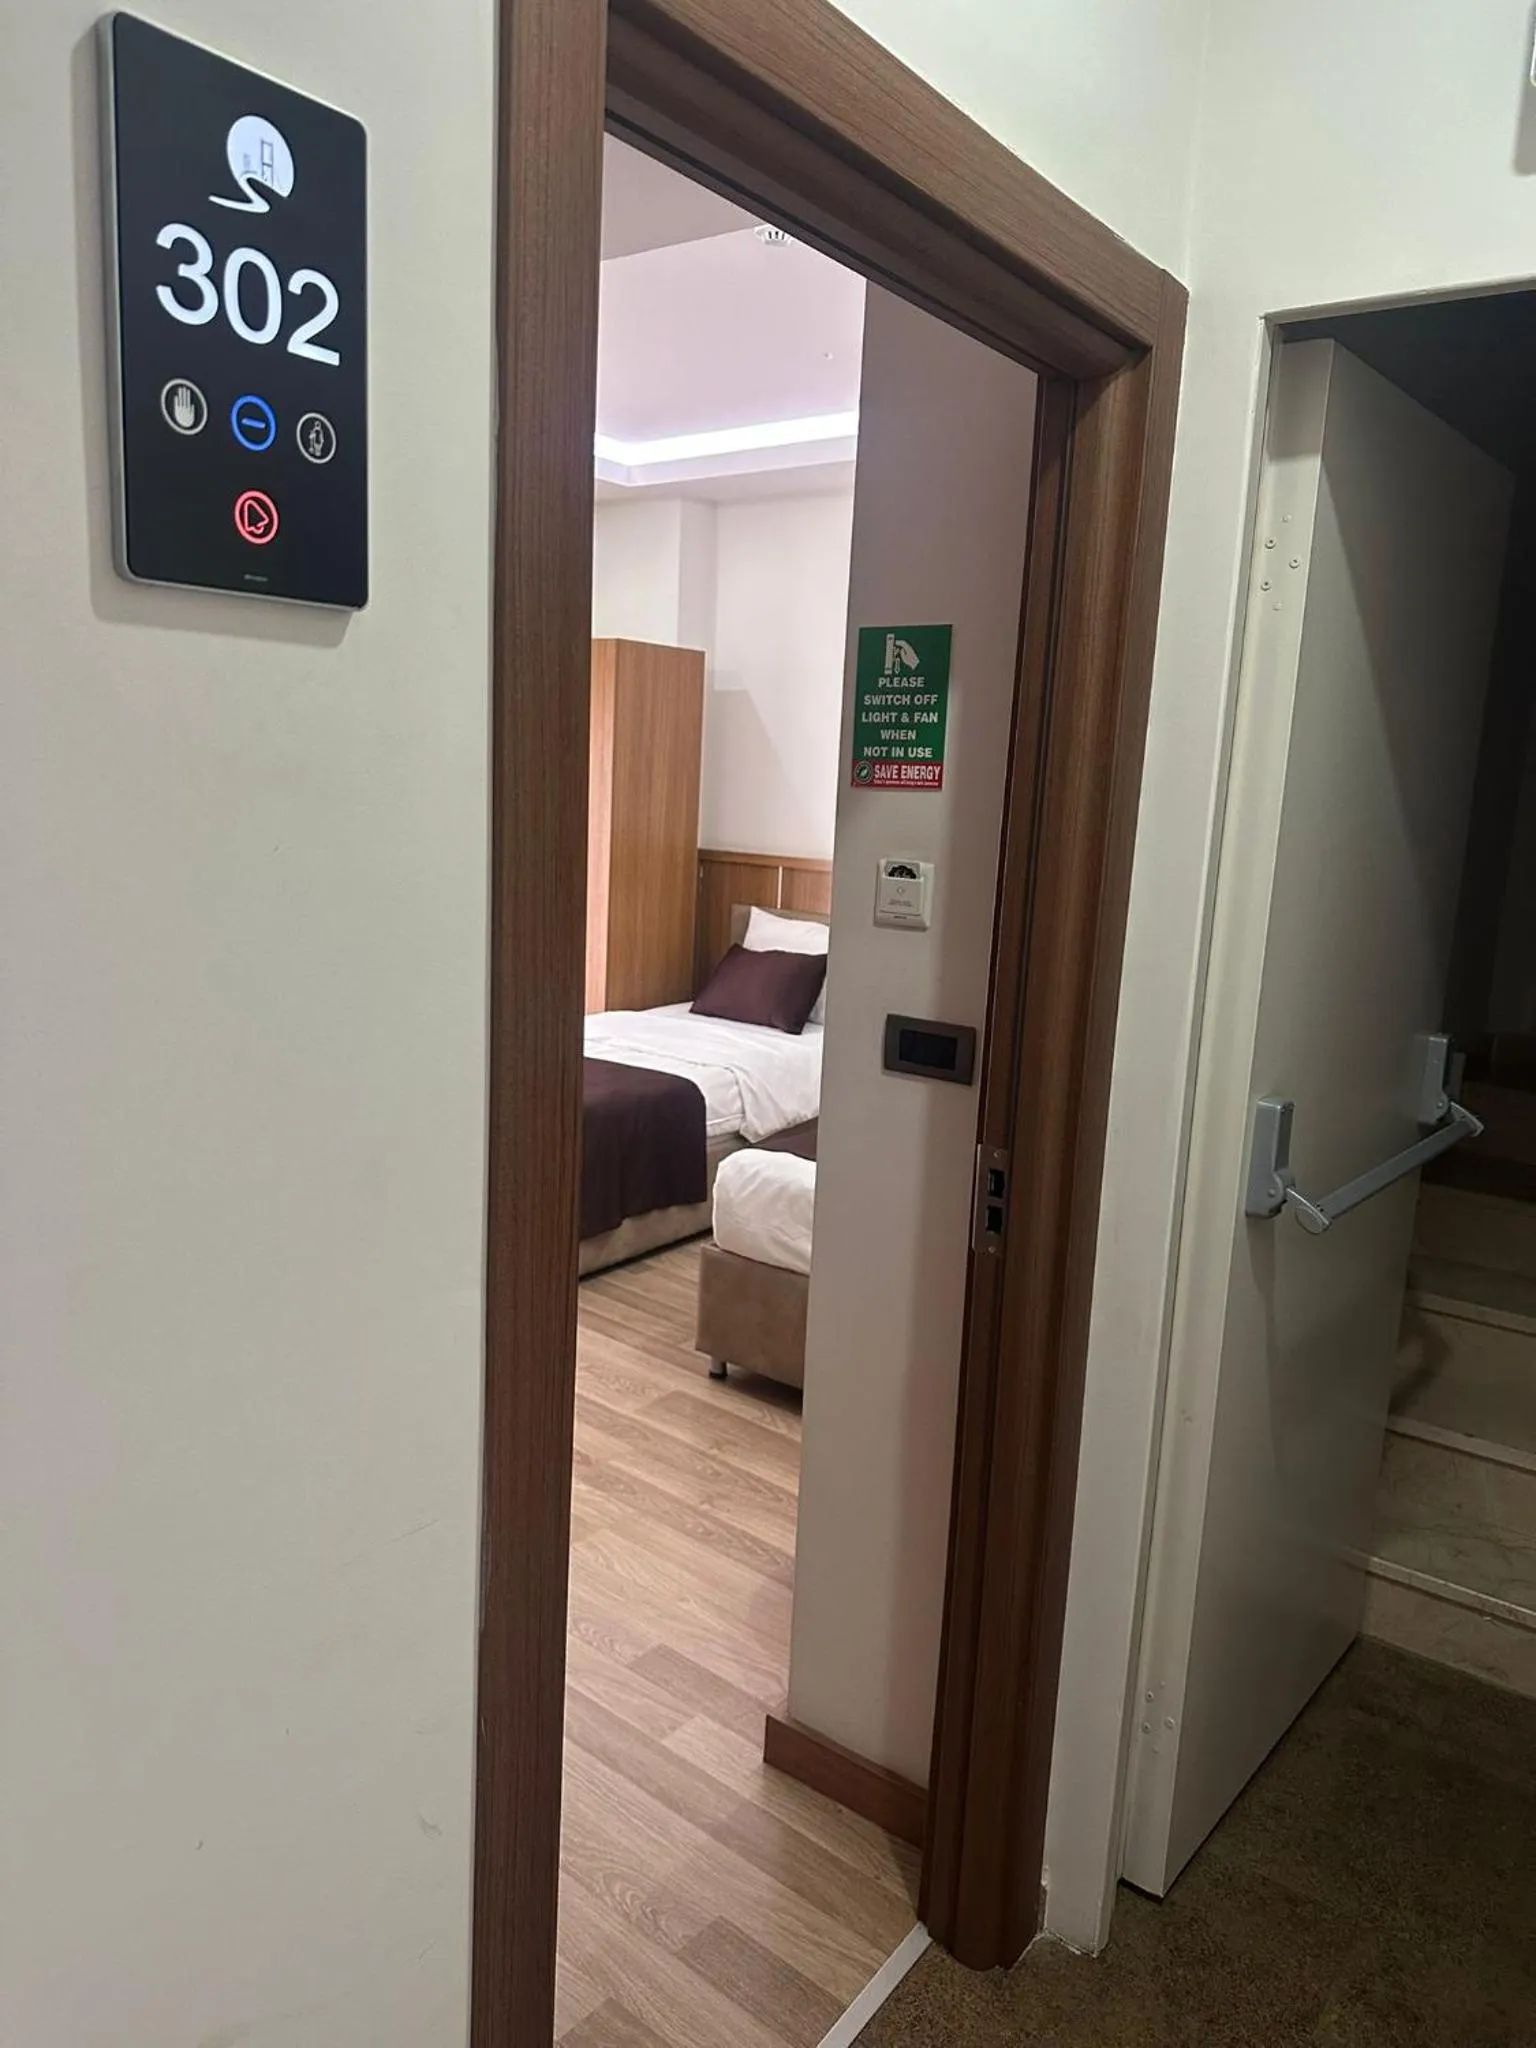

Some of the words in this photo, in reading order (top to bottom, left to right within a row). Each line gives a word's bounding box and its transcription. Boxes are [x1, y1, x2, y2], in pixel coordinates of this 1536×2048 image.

[155, 222, 341, 366] 302
[878, 677, 925, 688] PLEASE
[863, 694, 910, 706] SWITCH
[913, 694, 939, 706] OFF
[862, 712, 898, 723] LIGHT
[901, 712, 910, 723] &
[914, 712, 938, 723] FAN
[880, 729, 916, 740] WHEN
[863, 746, 889, 757] NOT
[891, 747, 904, 757] IN
[908, 747, 933, 758] USE
[874, 764, 898, 779] SAVE
[901, 765, 941, 781] ENERGY
